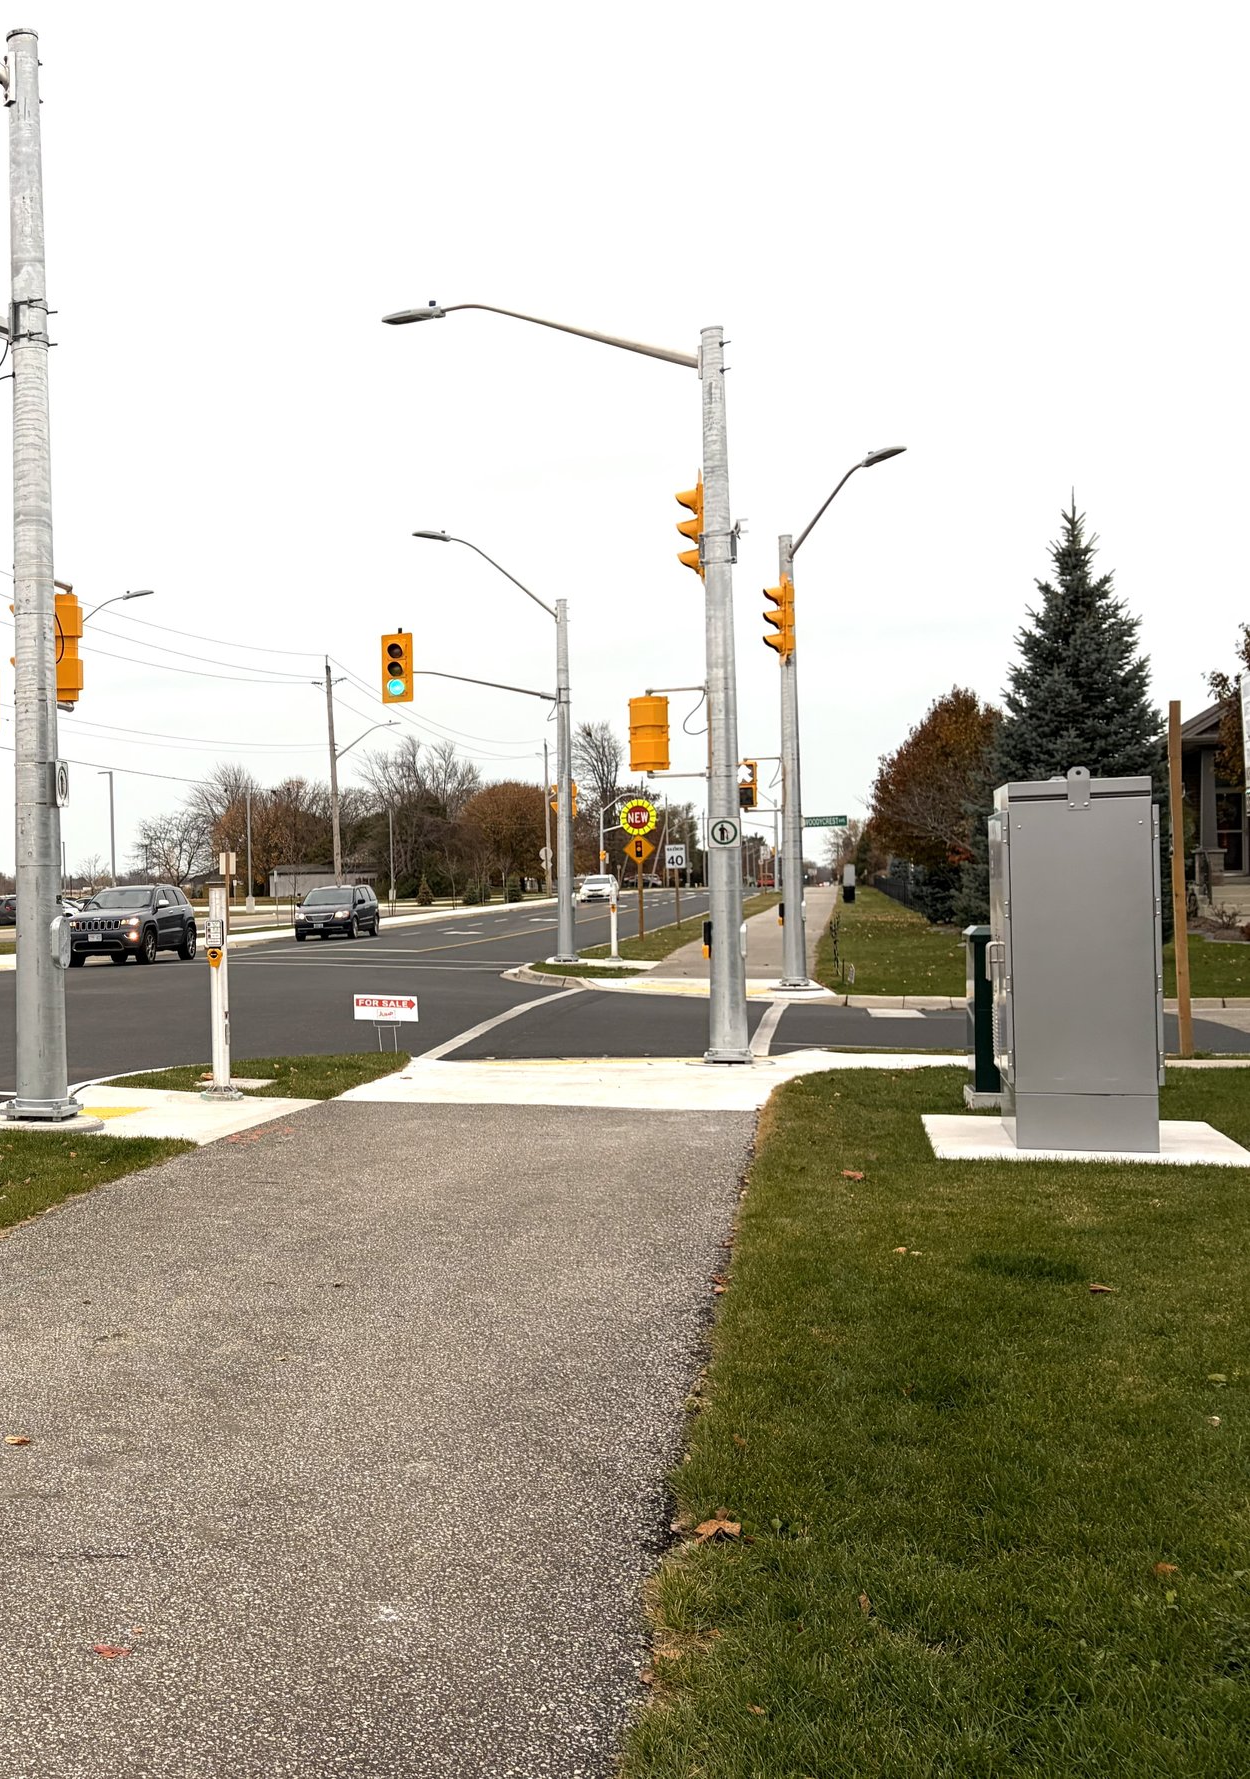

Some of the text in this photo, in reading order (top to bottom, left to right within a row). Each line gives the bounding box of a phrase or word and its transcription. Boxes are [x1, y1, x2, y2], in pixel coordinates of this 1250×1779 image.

[627, 811, 649, 824] NEW
[667, 855, 684, 866] 40
[358, 999, 409, 1008] FOR SALE
